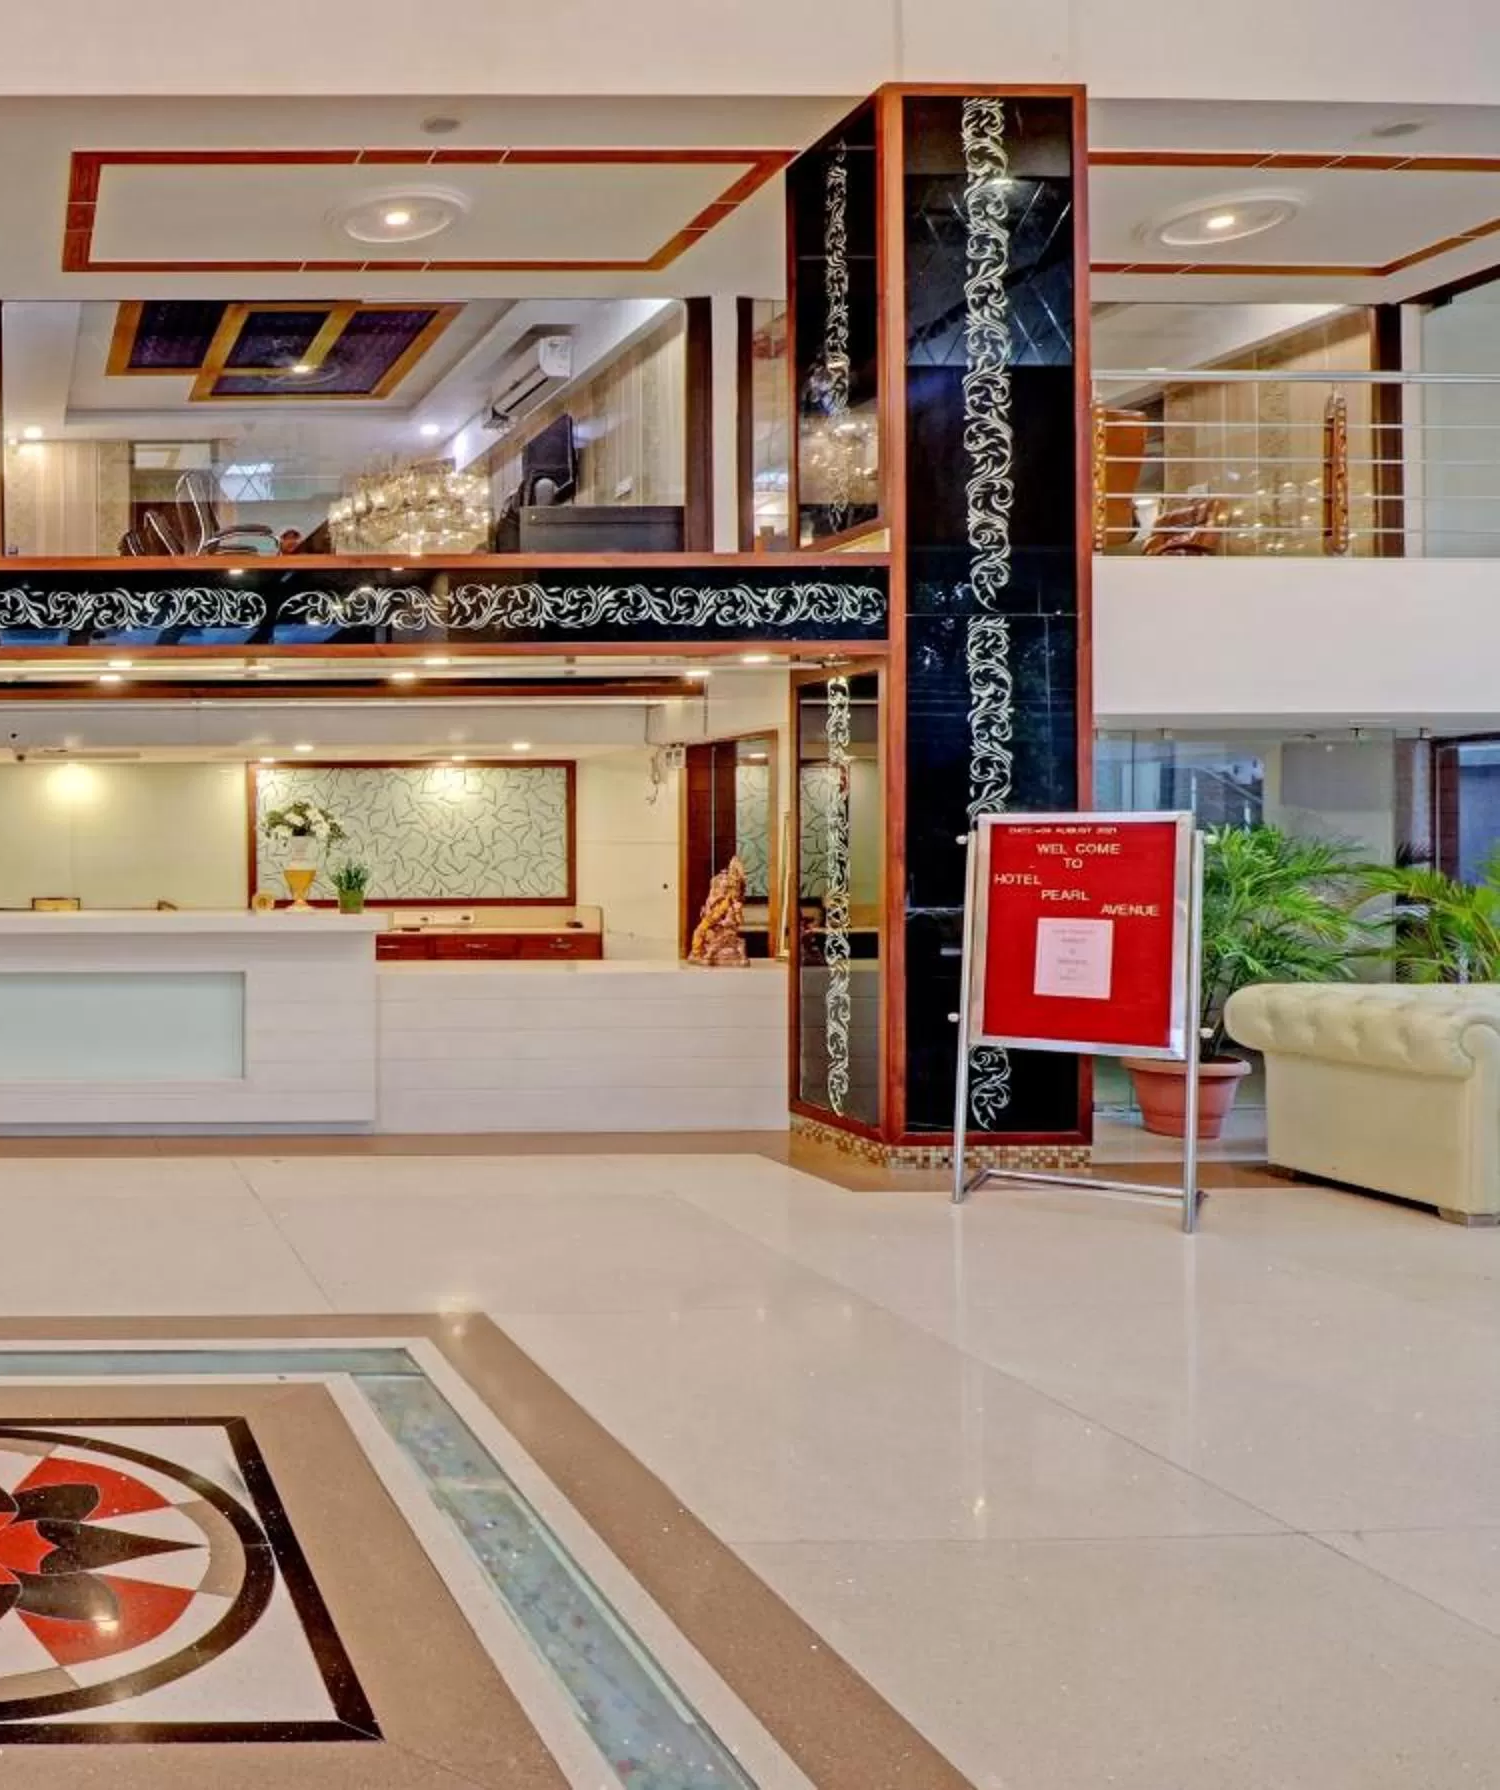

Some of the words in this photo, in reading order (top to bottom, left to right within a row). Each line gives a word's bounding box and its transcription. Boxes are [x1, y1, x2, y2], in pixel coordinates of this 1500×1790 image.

[1036, 843, 1067, 855] WEL
[1075, 843, 1121, 855] COME
[1063, 857, 1083, 869] TO
[994, 873, 1041, 885] HOTEL
[1041, 889, 1090, 901] PEARL
[1100, 903, 1160, 916] AVENUE
